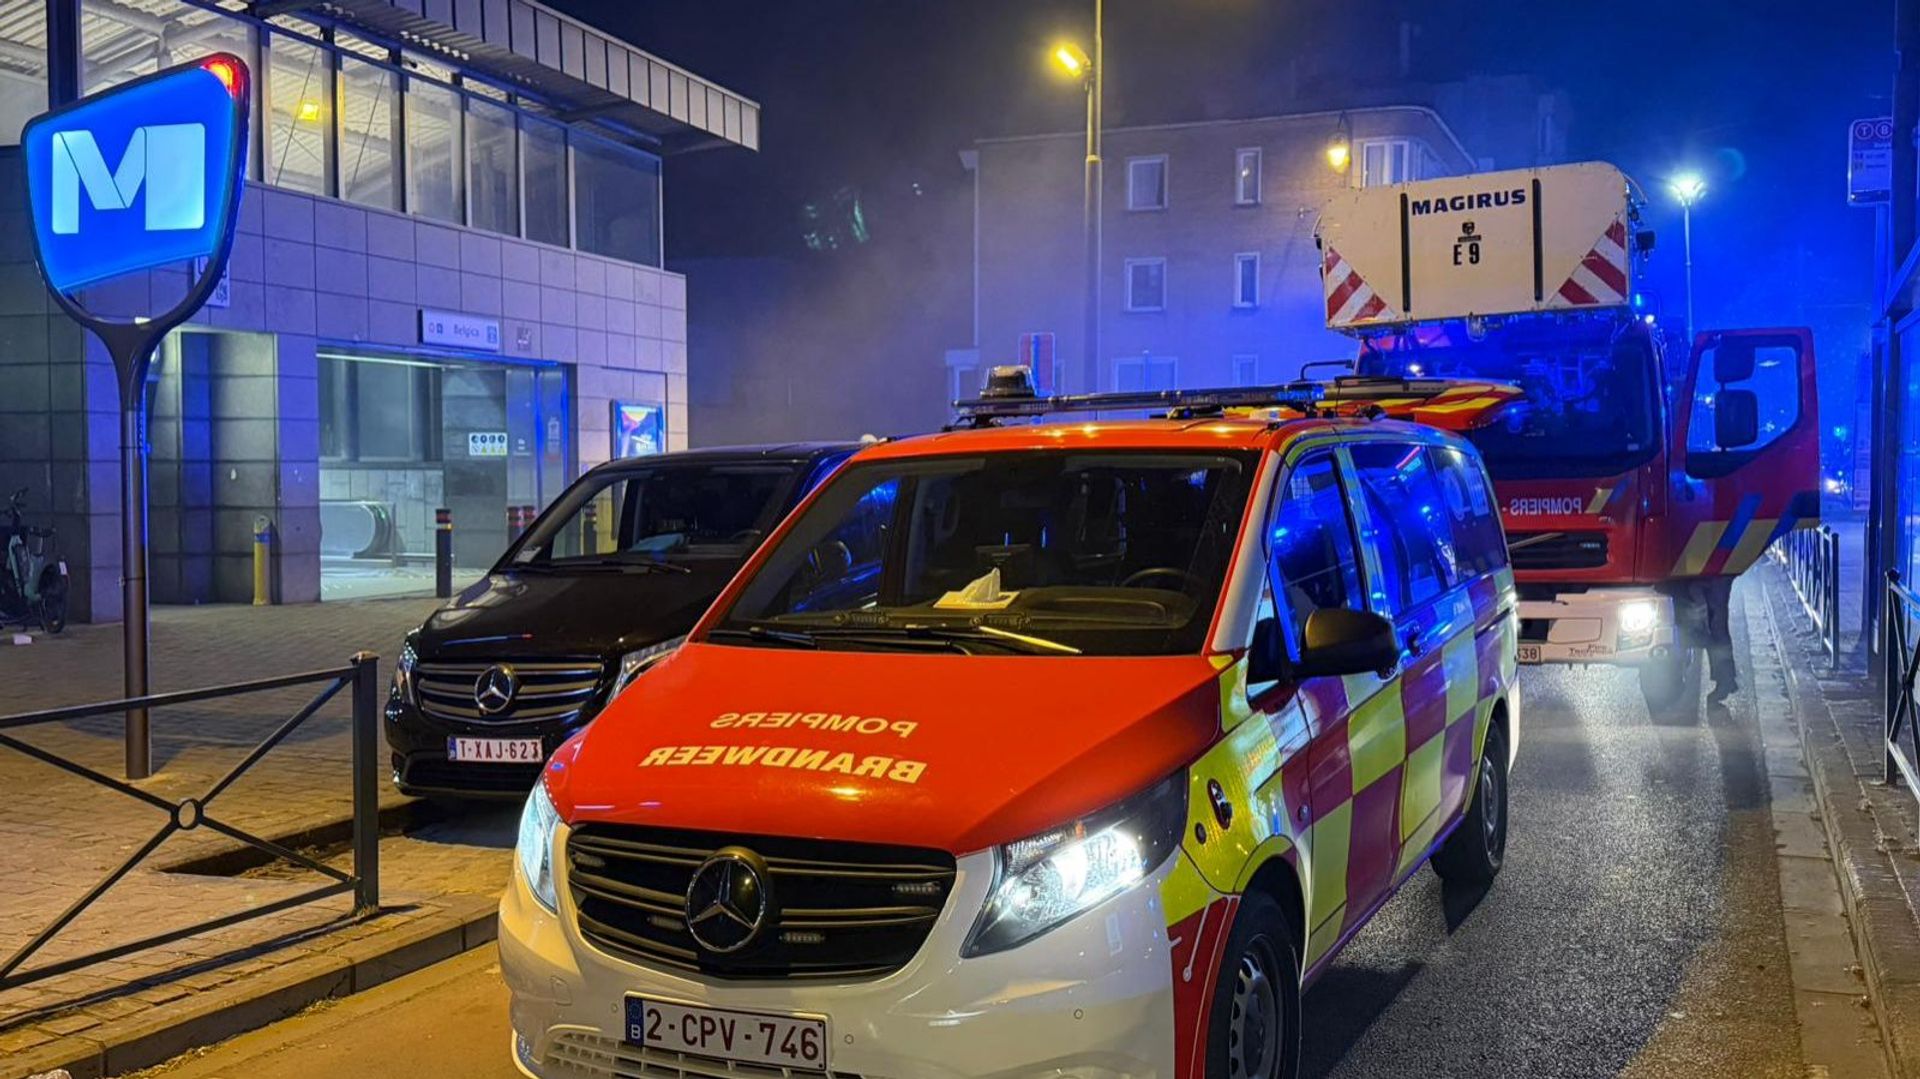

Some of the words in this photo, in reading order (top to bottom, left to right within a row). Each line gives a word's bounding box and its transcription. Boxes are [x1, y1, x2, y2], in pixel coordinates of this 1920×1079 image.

[52, 123, 205, 234] M
[1412, 189, 1526, 216] MAGIRUS
[1453, 244, 1462, 266] E
[1468, 242, 1480, 264] 9
[631, 1024, 641, 1039] B
[646, 1008, 819, 1061] 2-CPV-746
